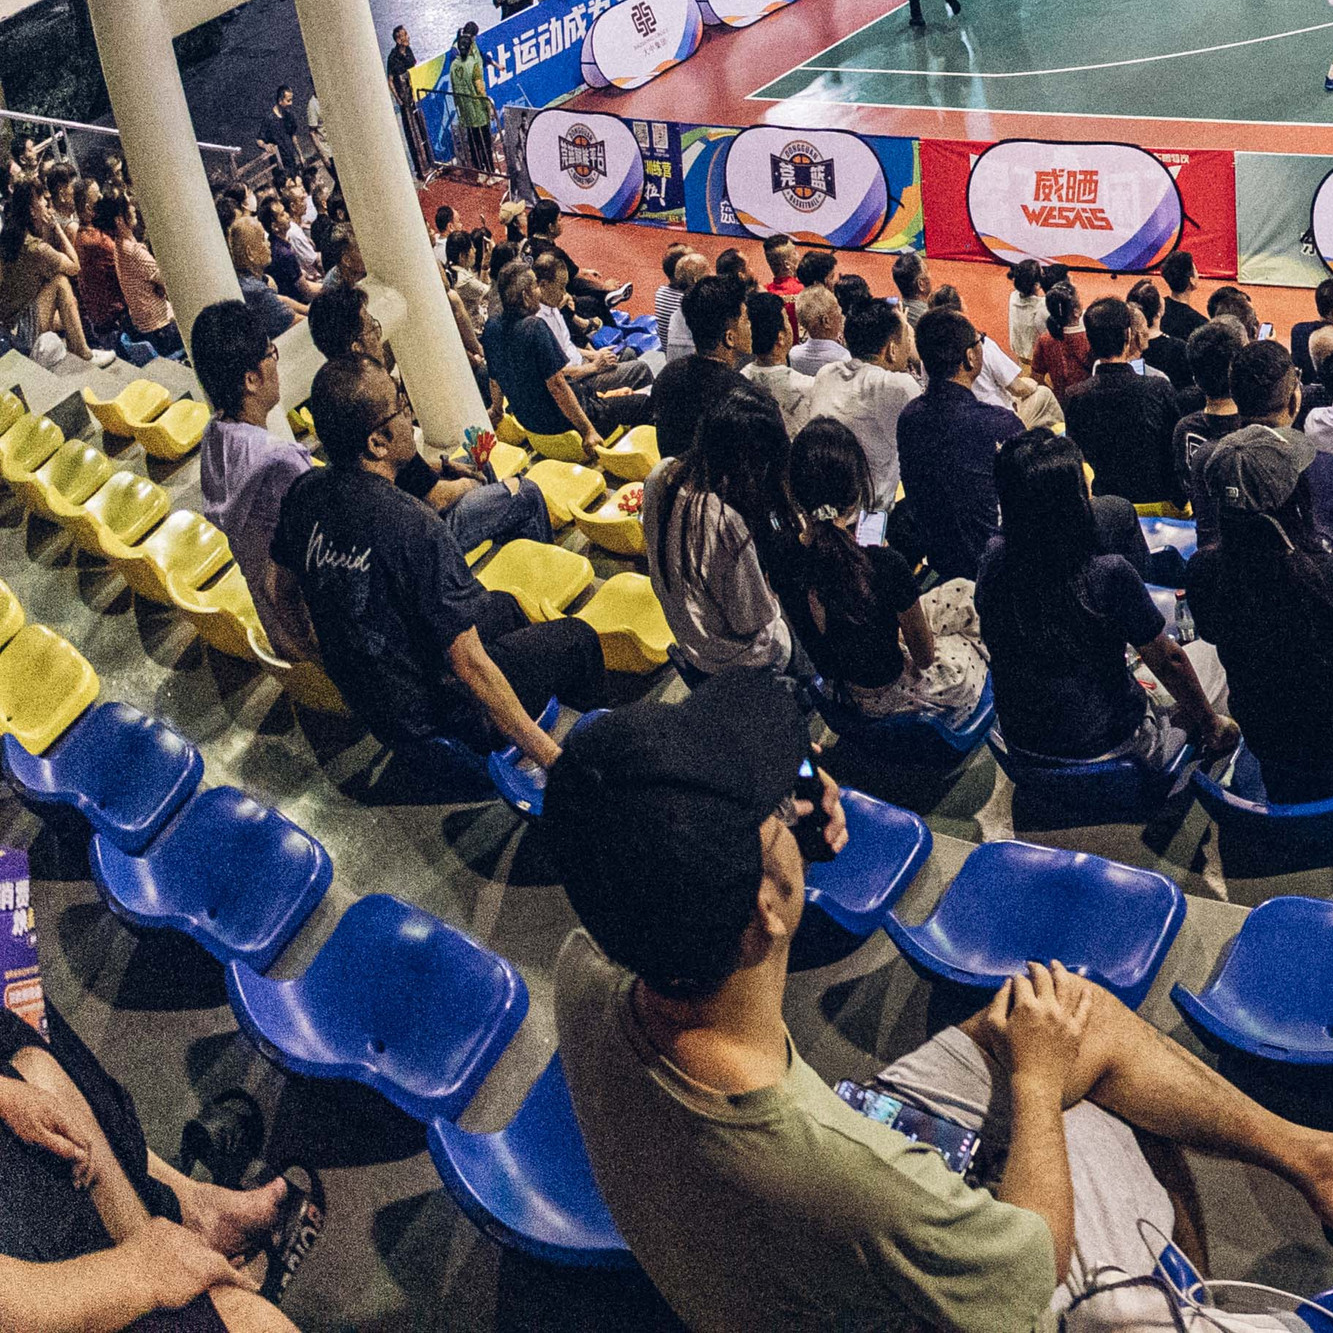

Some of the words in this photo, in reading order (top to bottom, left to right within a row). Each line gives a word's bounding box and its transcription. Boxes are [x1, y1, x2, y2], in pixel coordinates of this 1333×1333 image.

[784, 144, 818, 160] DONGGUAN
[1034, 168, 1099, 204] 威晒
[788, 196, 821, 210] BASKETBALL
